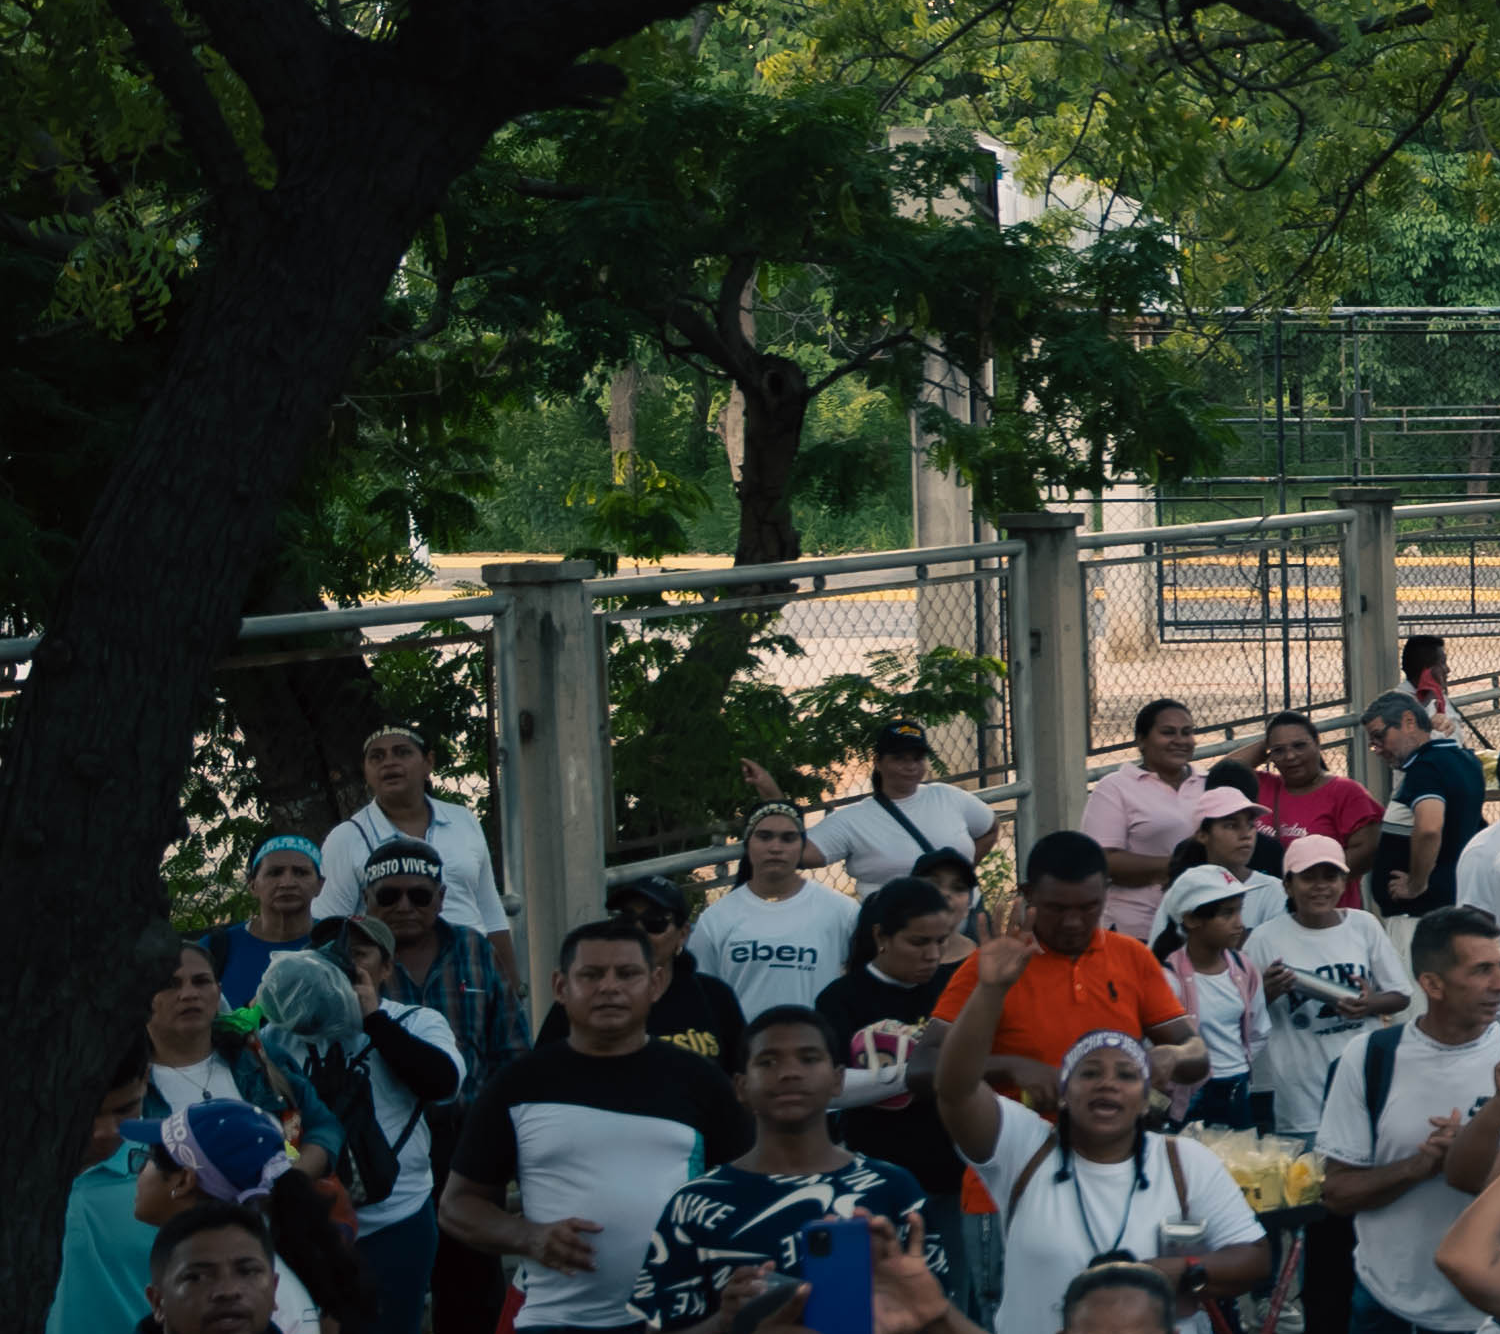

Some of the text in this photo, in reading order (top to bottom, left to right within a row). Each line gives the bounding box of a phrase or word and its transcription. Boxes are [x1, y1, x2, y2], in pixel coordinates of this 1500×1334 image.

[401, 858, 428, 875] VIVE
[731, 941, 818, 964] eben
[671, 1193, 737, 1230] NIKE
